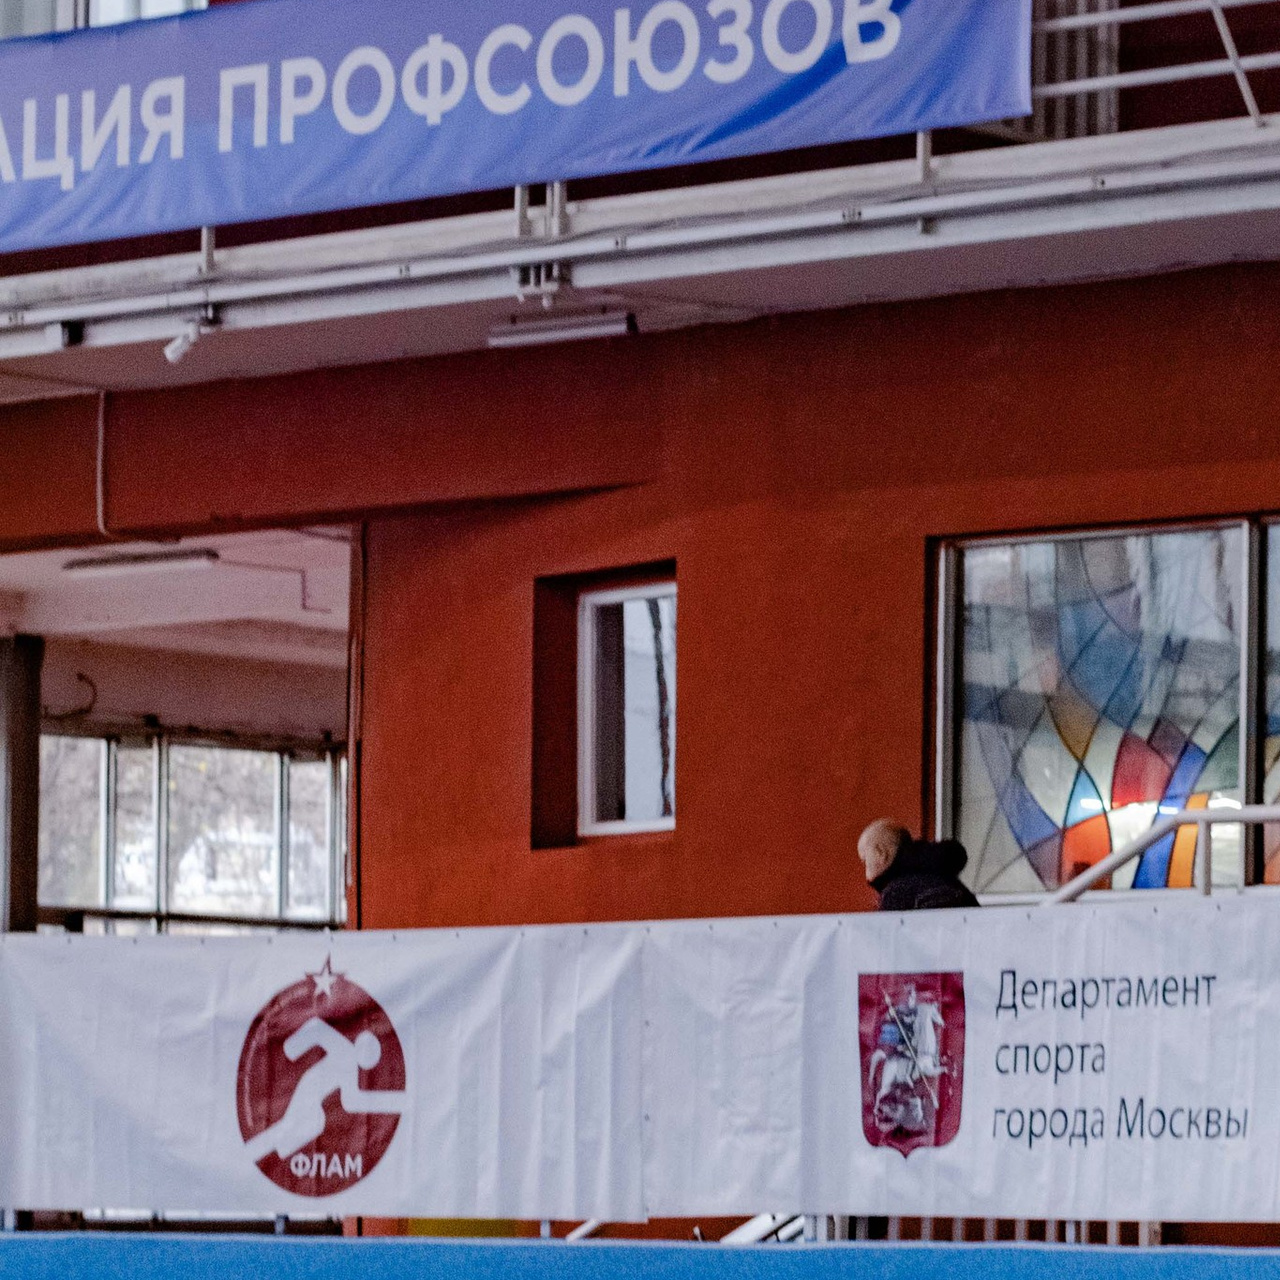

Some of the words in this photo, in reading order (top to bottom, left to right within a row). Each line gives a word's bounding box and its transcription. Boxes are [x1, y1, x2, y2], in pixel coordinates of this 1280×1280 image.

[0, 75, 185, 191] ЦИЯ
[218, 0, 902, 153] ПРОФСОЮЗОВ
[996, 969, 1217, 1020] Департамент
[995, 1042, 1105, 1084] спорта
[992, 1107, 1104, 1149] города
[1116, 1097, 1249, 1138] Москвы
[290, 1154, 363, 1178] ФЛАМ
